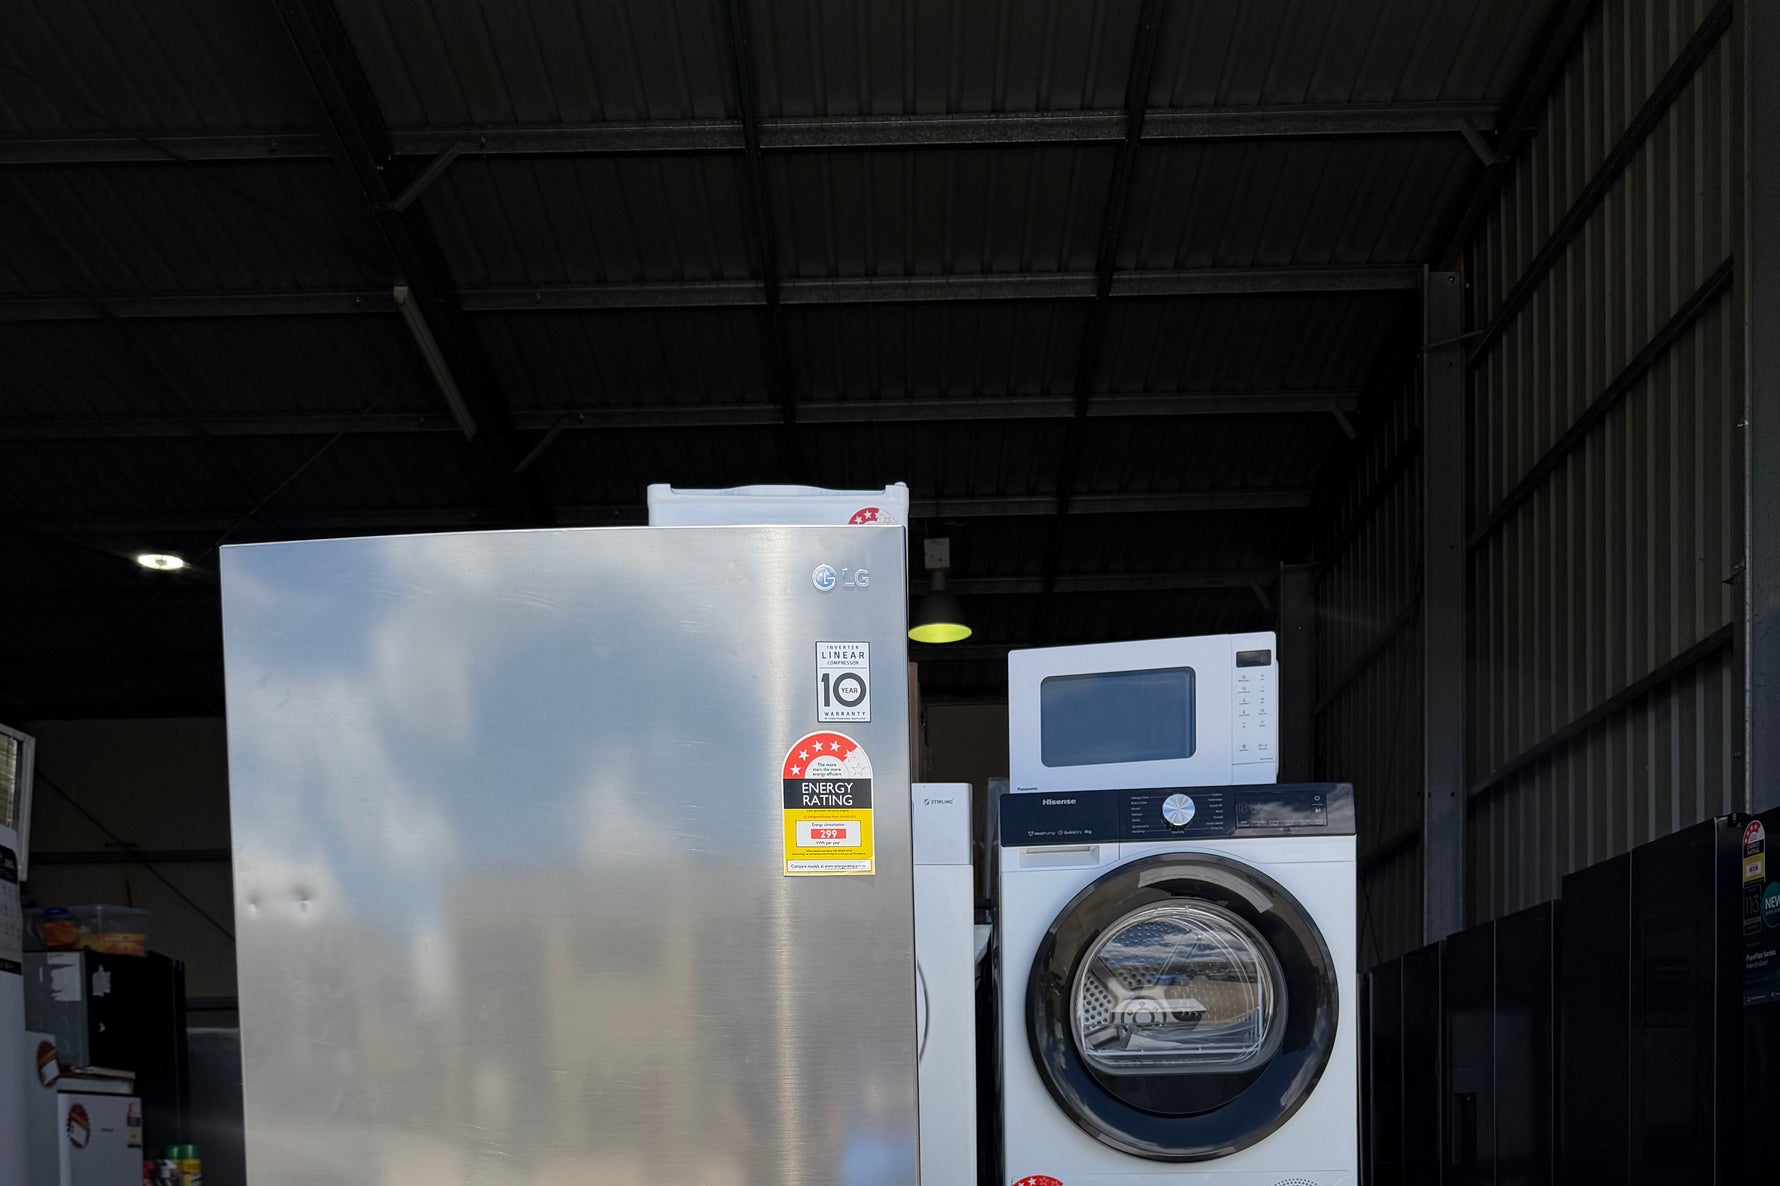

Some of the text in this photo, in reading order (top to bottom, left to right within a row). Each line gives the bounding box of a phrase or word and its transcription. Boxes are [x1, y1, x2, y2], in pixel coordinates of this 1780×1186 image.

[842, 568, 869, 587] LG
[821, 672, 866, 707] 10
[802, 783, 853, 794] ENERGY
[803, 795, 853, 806] RATING
[820, 830, 837, 838] 299
